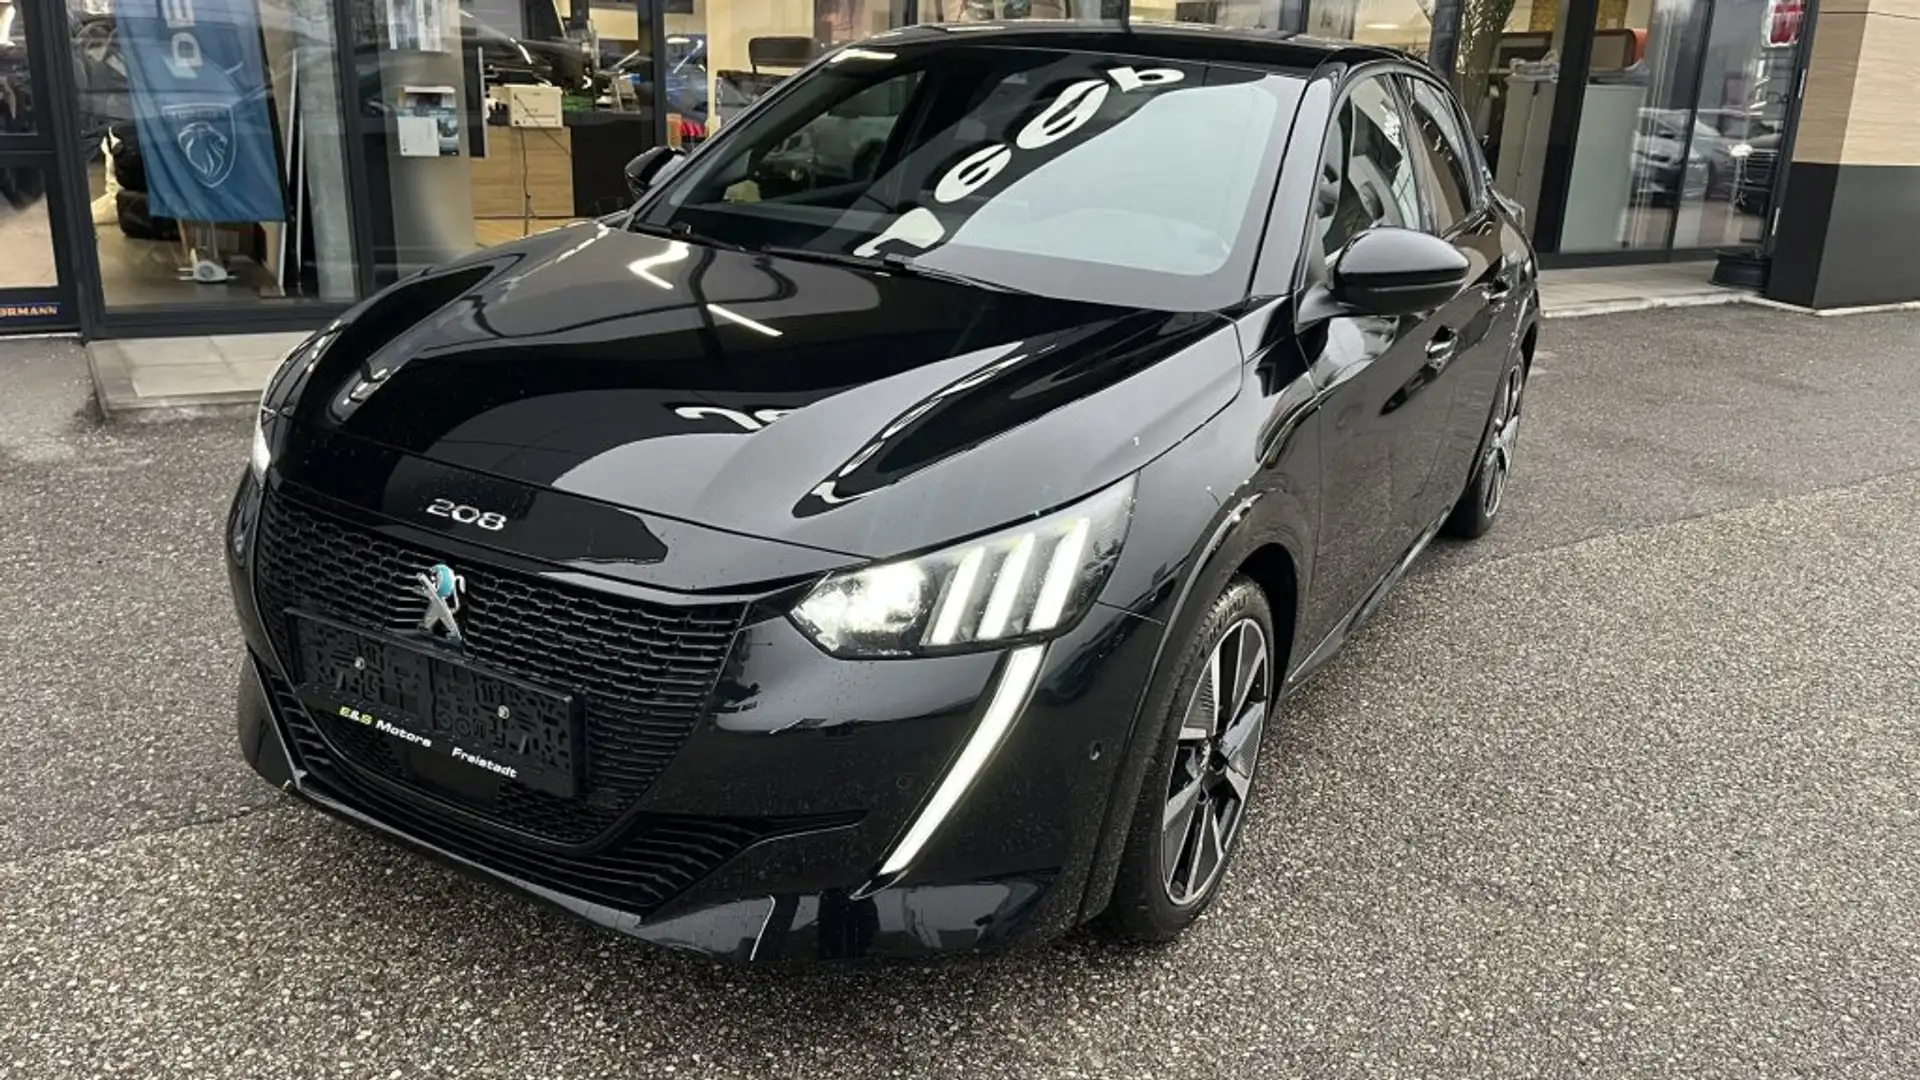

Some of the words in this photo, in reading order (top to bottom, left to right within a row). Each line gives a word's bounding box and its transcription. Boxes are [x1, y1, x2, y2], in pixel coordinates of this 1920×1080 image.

[426, 498, 507, 531] 208
[339, 706, 373, 725] E&S
[375, 719, 432, 748] Motors
[452, 746, 517, 778] Freistadt
